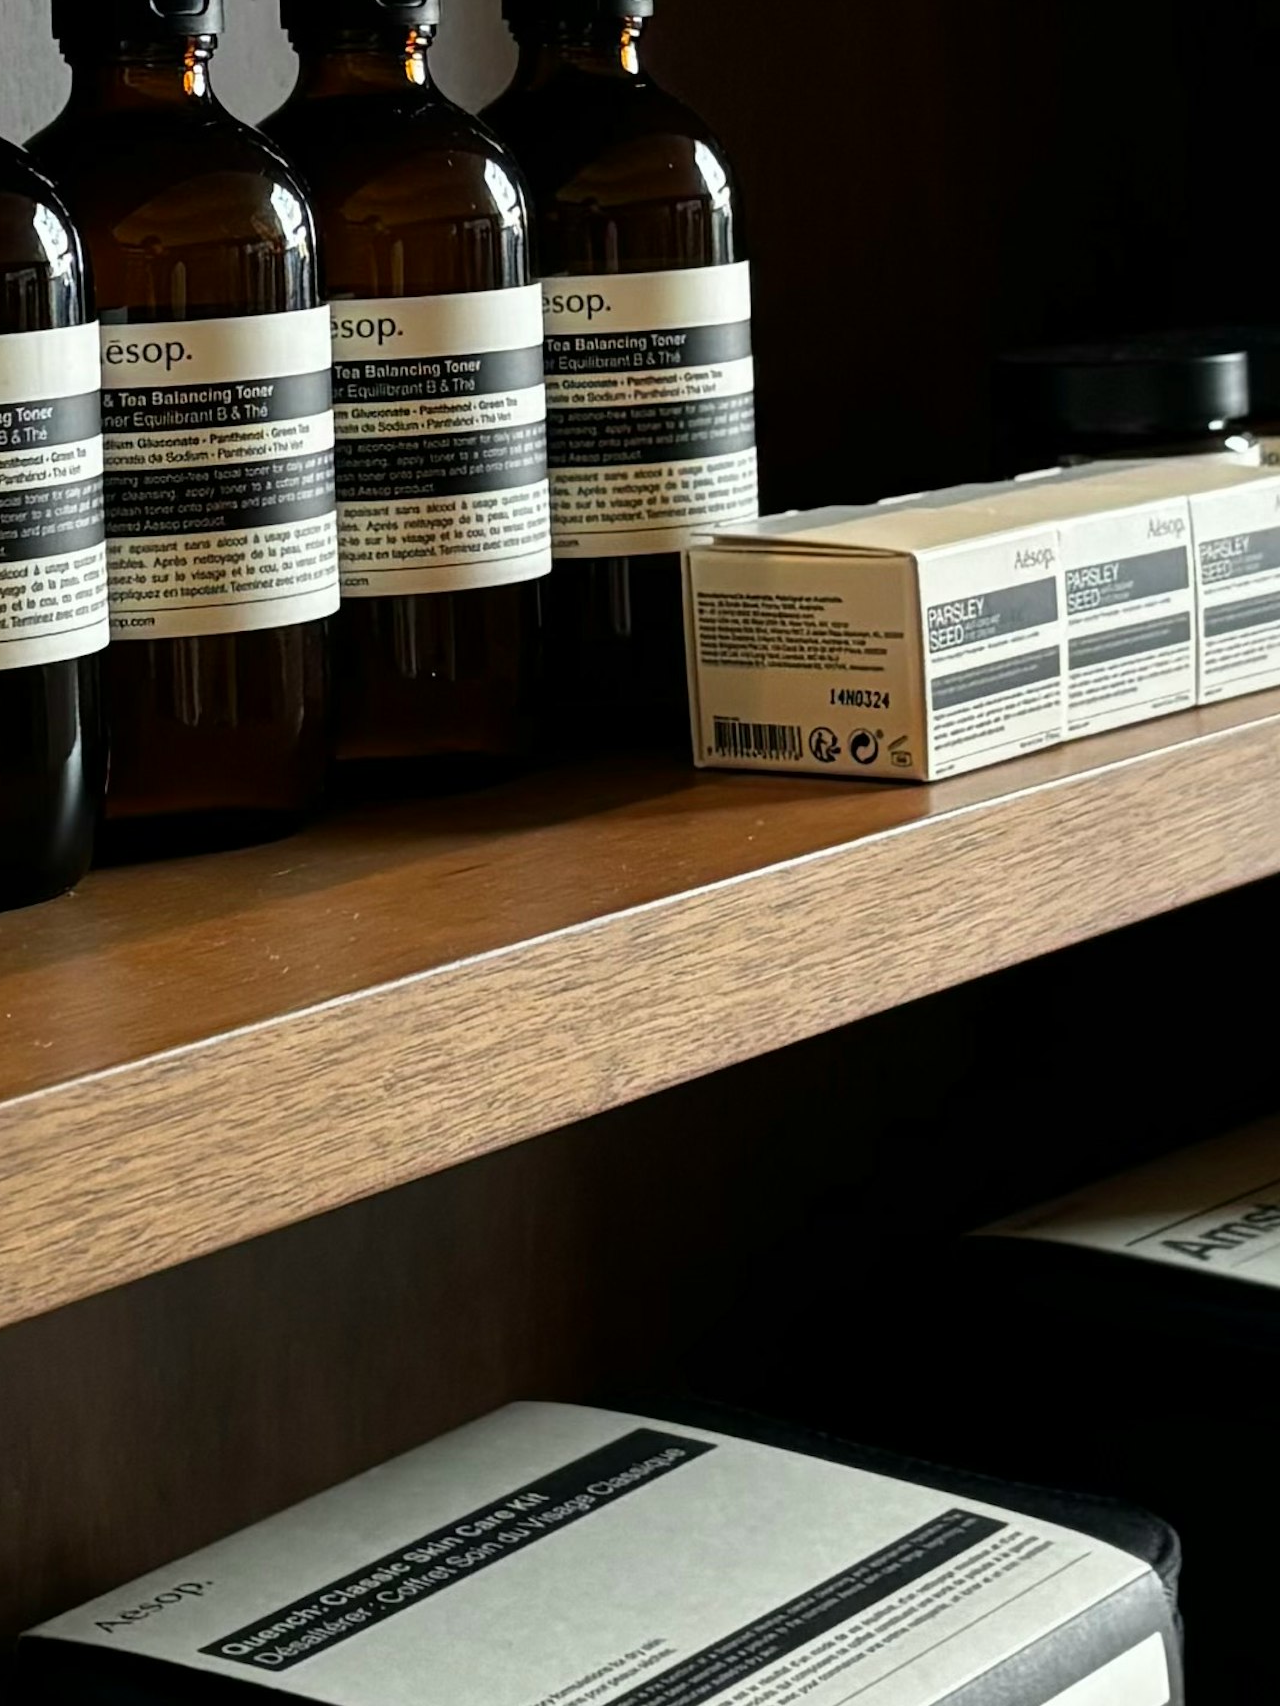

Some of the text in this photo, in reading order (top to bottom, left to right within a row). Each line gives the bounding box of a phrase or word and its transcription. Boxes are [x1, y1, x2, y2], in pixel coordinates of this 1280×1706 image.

[105, 340, 193, 371] ēsop.
[335, 358, 481, 380] Tea Balancing Toner
[118, 383, 275, 407] Tea Balancing Toner
[15, 404, 53, 422] Toner
[12, 428, 21, 445] &
[23, 424, 48, 443] Thé
[1066, 563, 1120, 590] PARSLEY
[928, 597, 985, 624] PARSLEY
[1067, 588, 1102, 614] SEED
[929, 625, 964, 652] SEED
[830, 688, 890, 709] 14N0324
[451, 1537, 500, 1569] Soin
[497, 1519, 525, 1547] du
[520, 1490, 597, 1534] Visage
[587, 1446, 687, 1497] Classique
[221, 1491, 550, 1657] Quench: Classic Skin Care Kit
